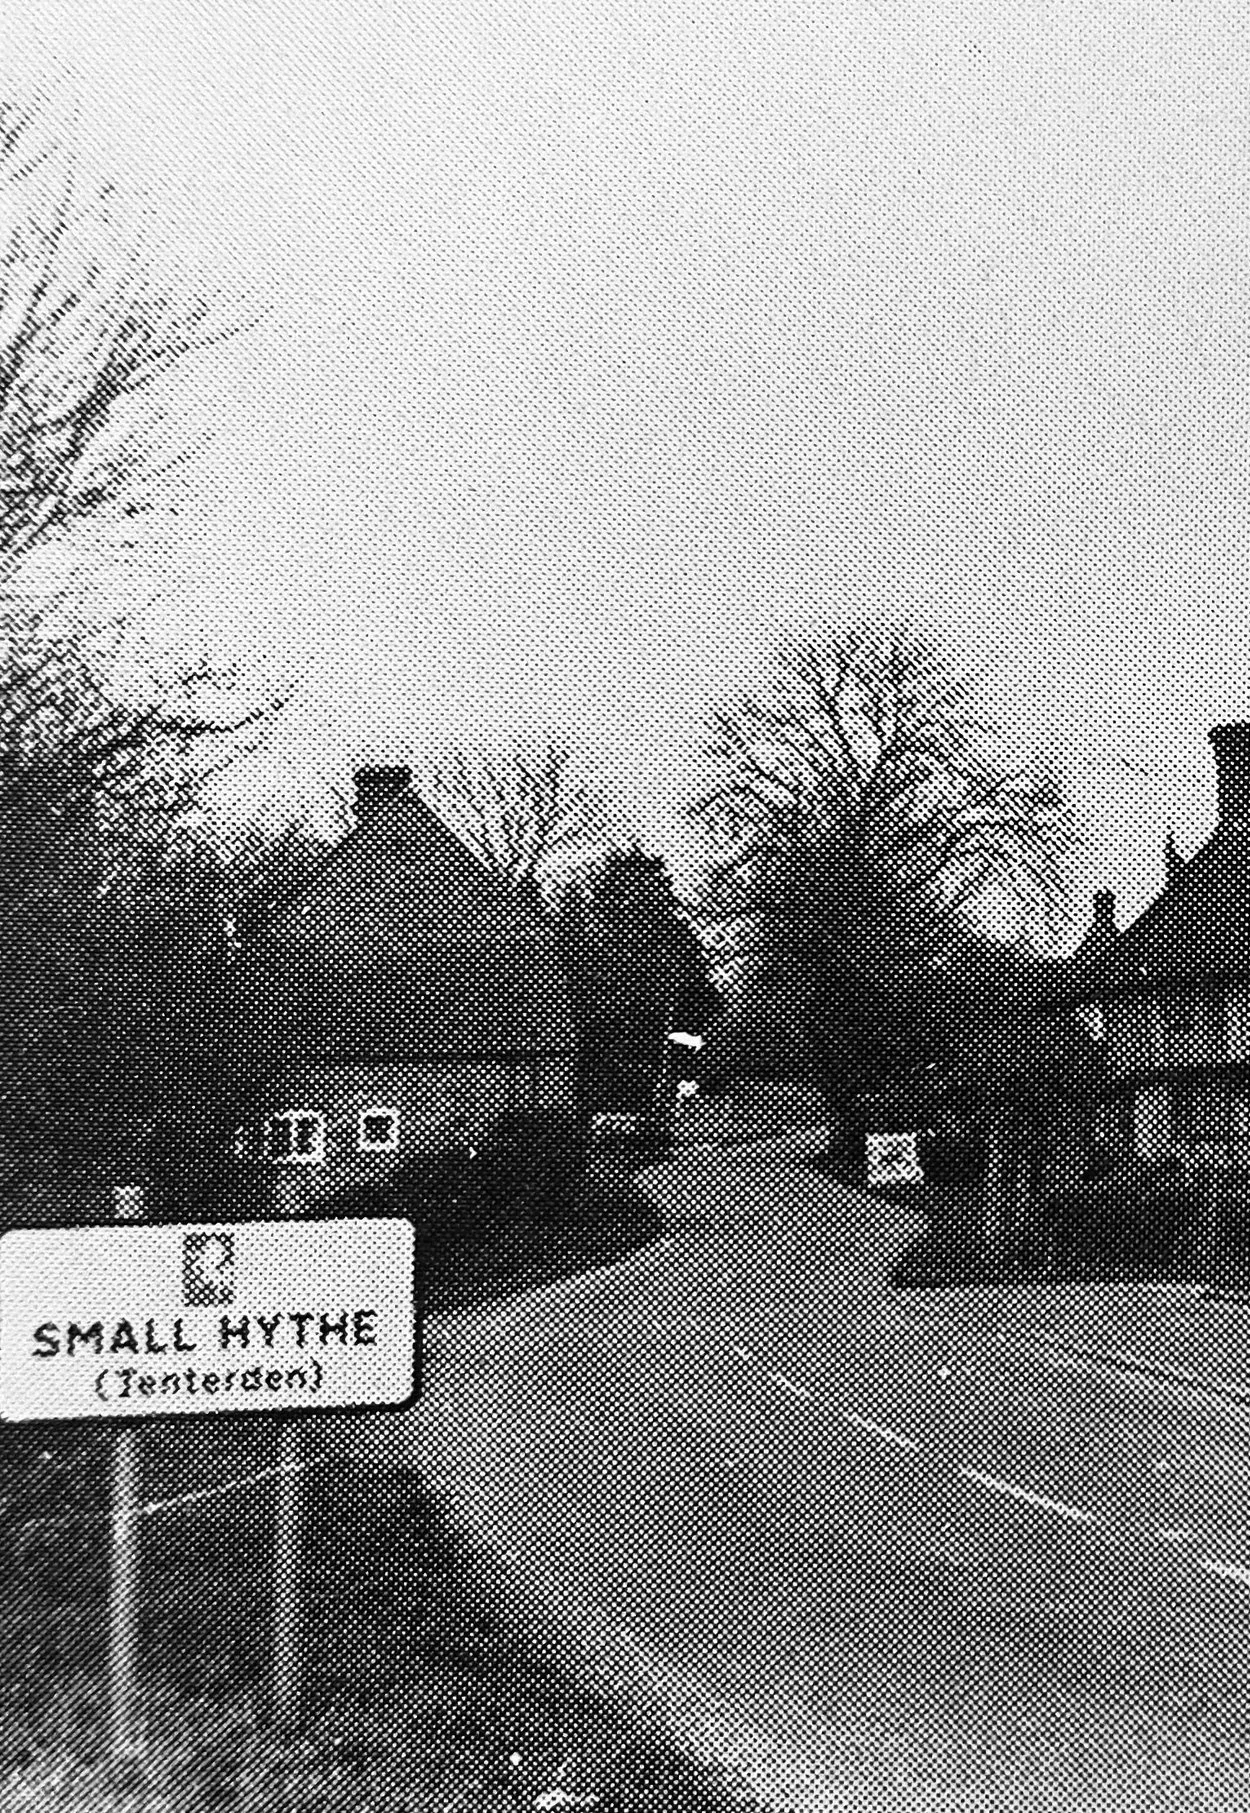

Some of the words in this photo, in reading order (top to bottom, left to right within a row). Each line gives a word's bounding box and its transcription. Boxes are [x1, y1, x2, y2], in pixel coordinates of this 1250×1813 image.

[32, 1318, 197, 1358] SMALL
[219, 1309, 378, 1349] HYTHE
[96, 1356, 323, 1401] (Tenterden)
